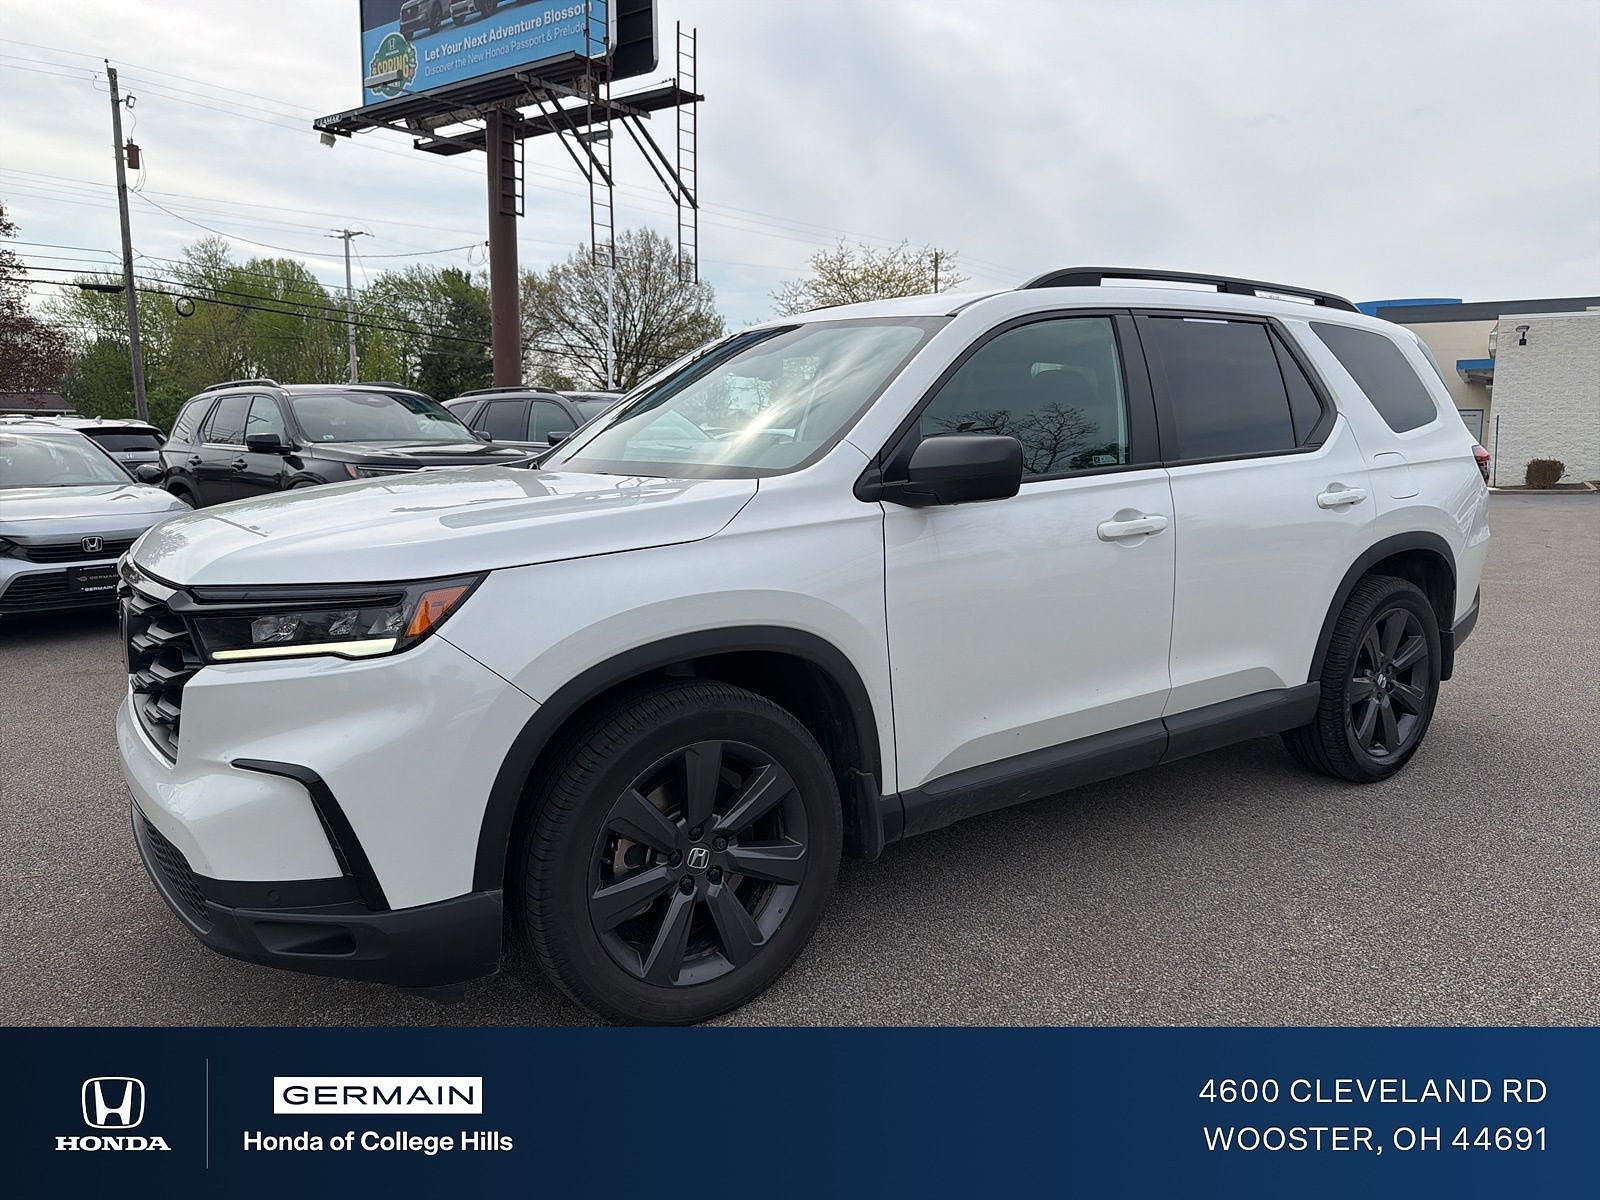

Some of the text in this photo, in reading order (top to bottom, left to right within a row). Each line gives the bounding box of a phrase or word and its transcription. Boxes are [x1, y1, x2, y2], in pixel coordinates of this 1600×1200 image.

[424, 1, 593, 62] Let Your Next Adventure Blossom
[424, 21, 587, 77] Discover the New Honda Passport & Prelude
